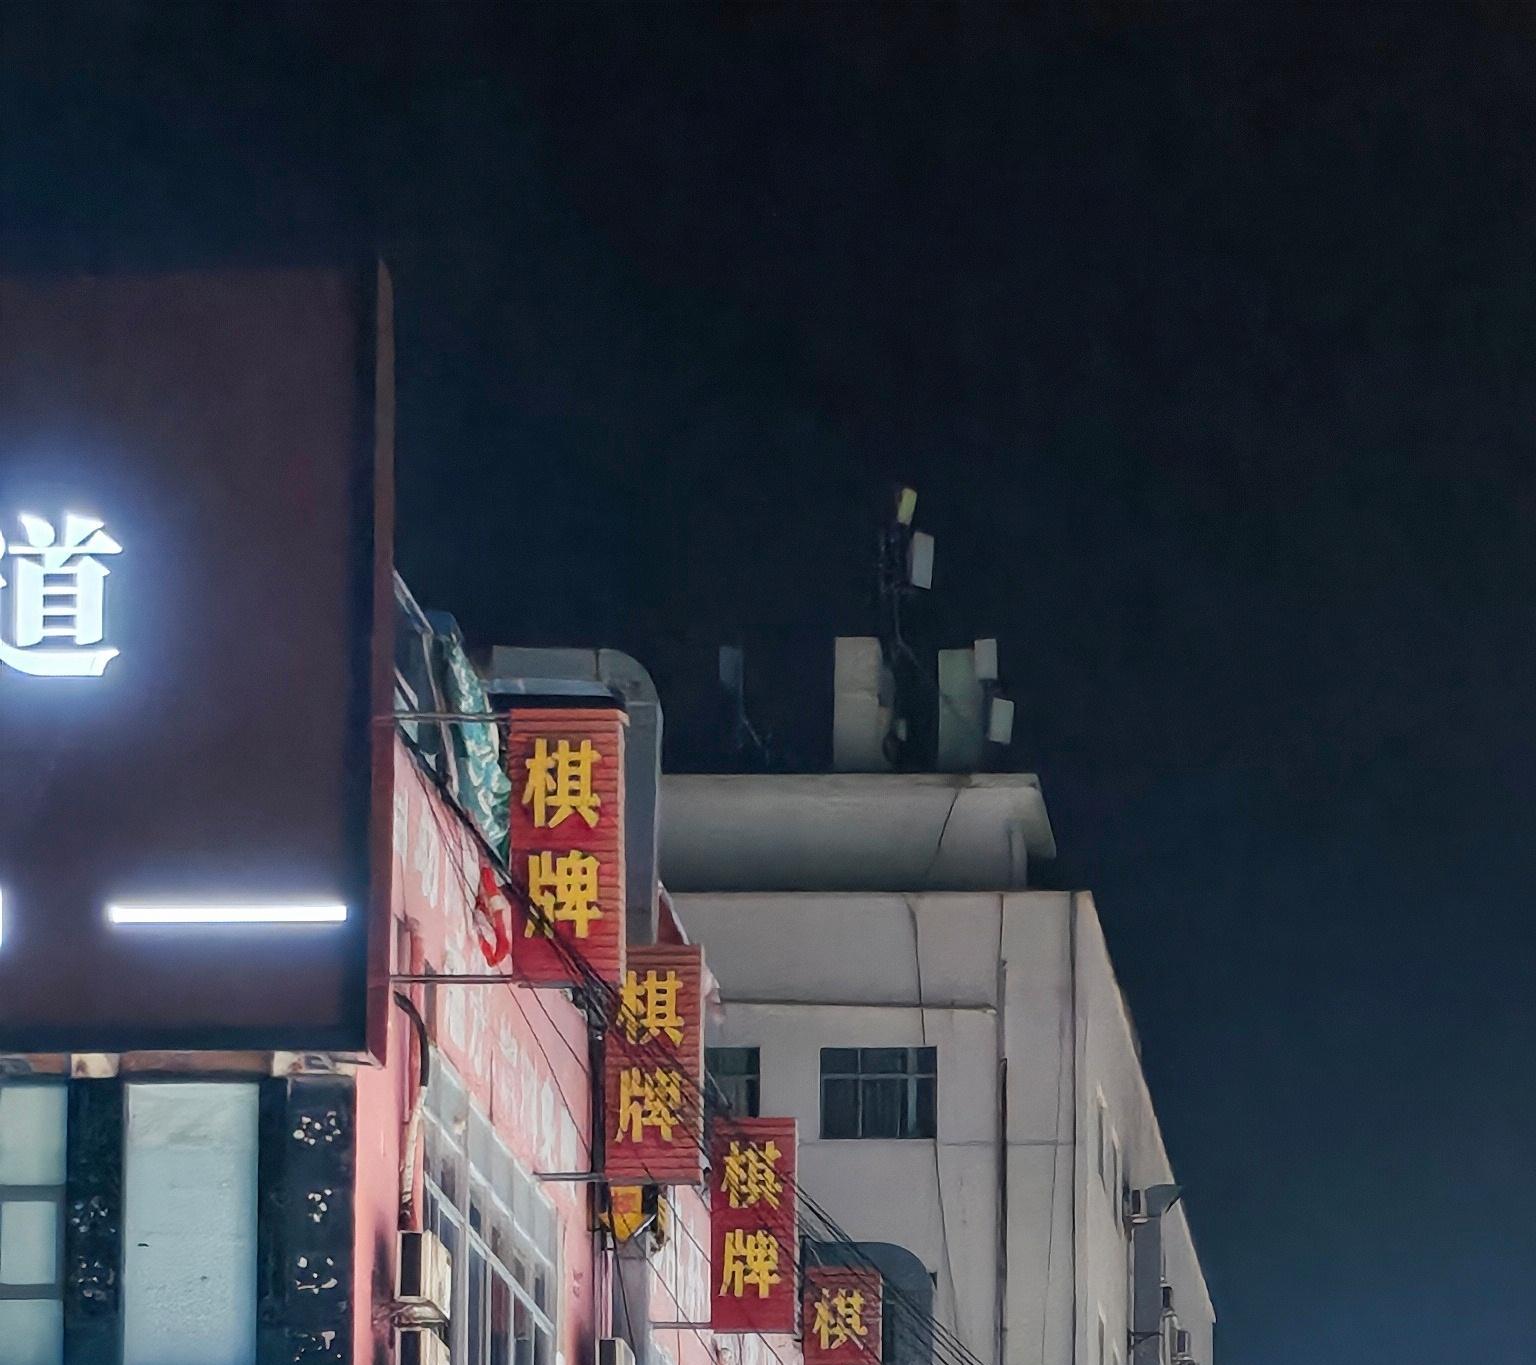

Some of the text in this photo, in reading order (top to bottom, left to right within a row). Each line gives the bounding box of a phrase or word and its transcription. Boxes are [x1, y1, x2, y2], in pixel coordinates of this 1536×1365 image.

[0, 512, 123, 677] 道
[521, 737, 603, 939] 棋牌
[616, 970, 685, 1143] 棋牌
[718, 1140, 782, 1298] 棋牌
